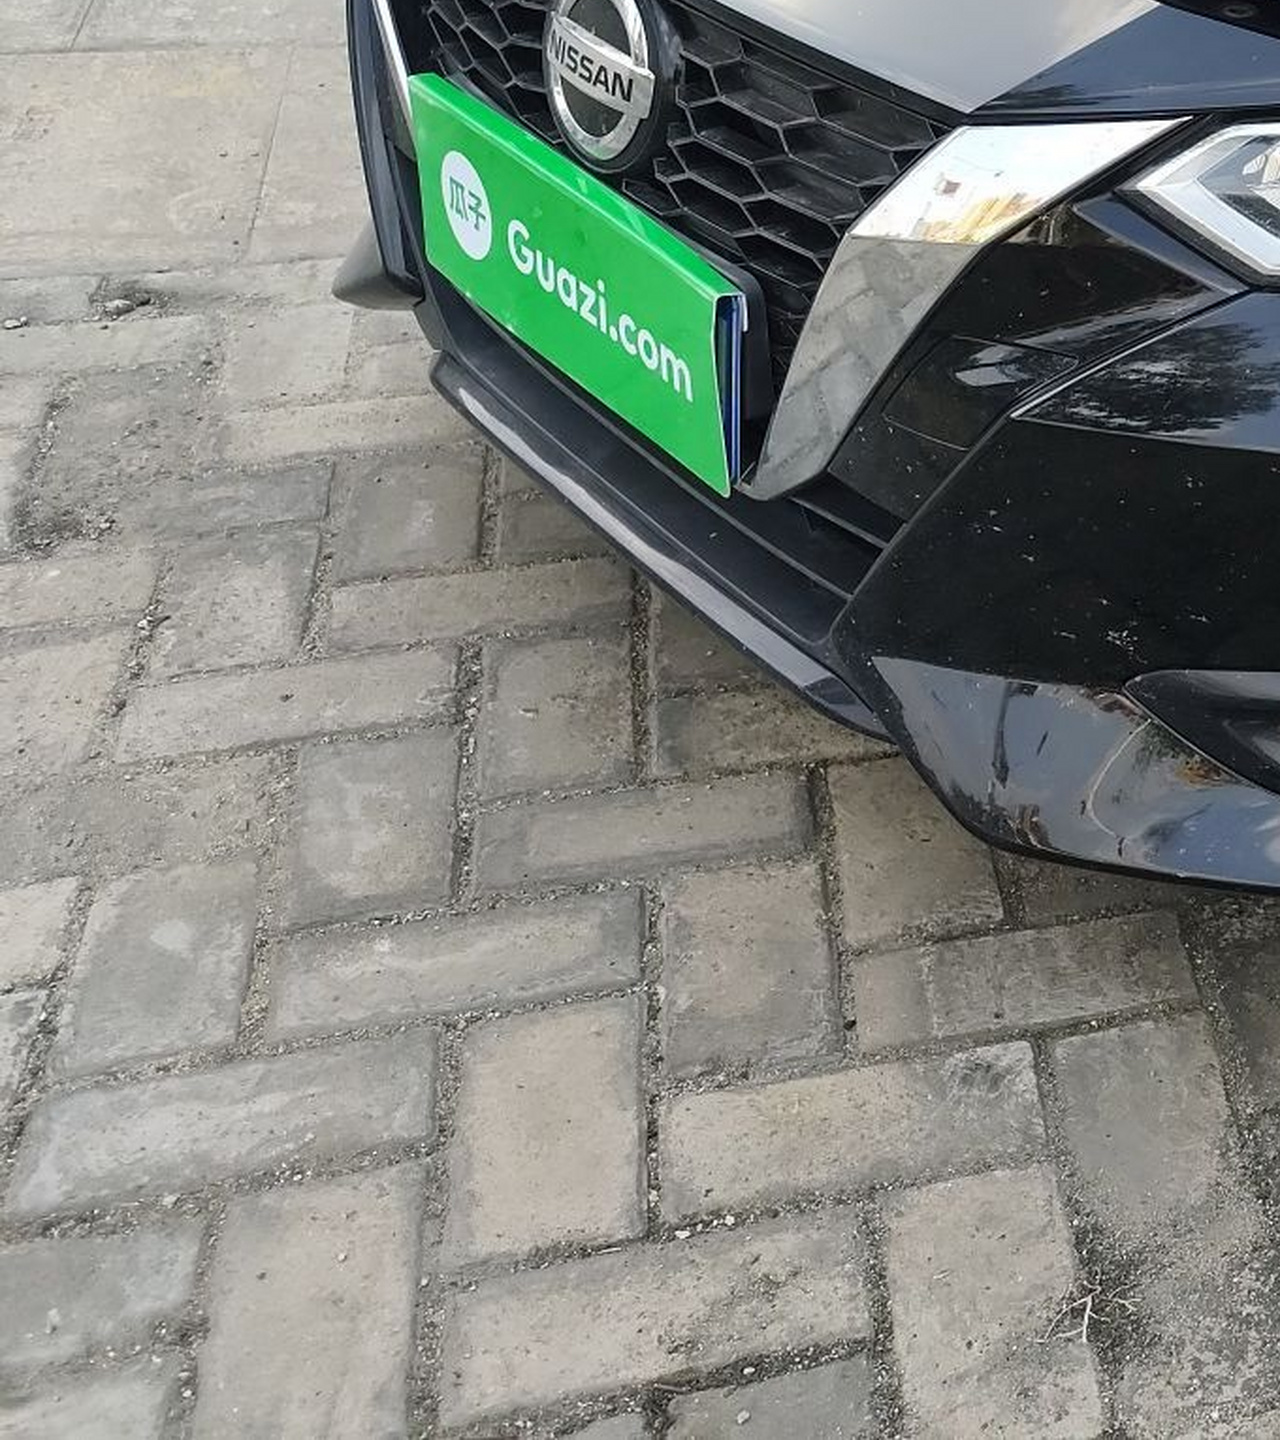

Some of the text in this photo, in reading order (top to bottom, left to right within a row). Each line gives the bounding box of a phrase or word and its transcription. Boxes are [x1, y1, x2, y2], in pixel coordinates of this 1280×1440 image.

[548, 26, 635, 104] NISSAN
[446, 173, 488, 235] 瓜子
[506, 218, 696, 402] Guazi.com
